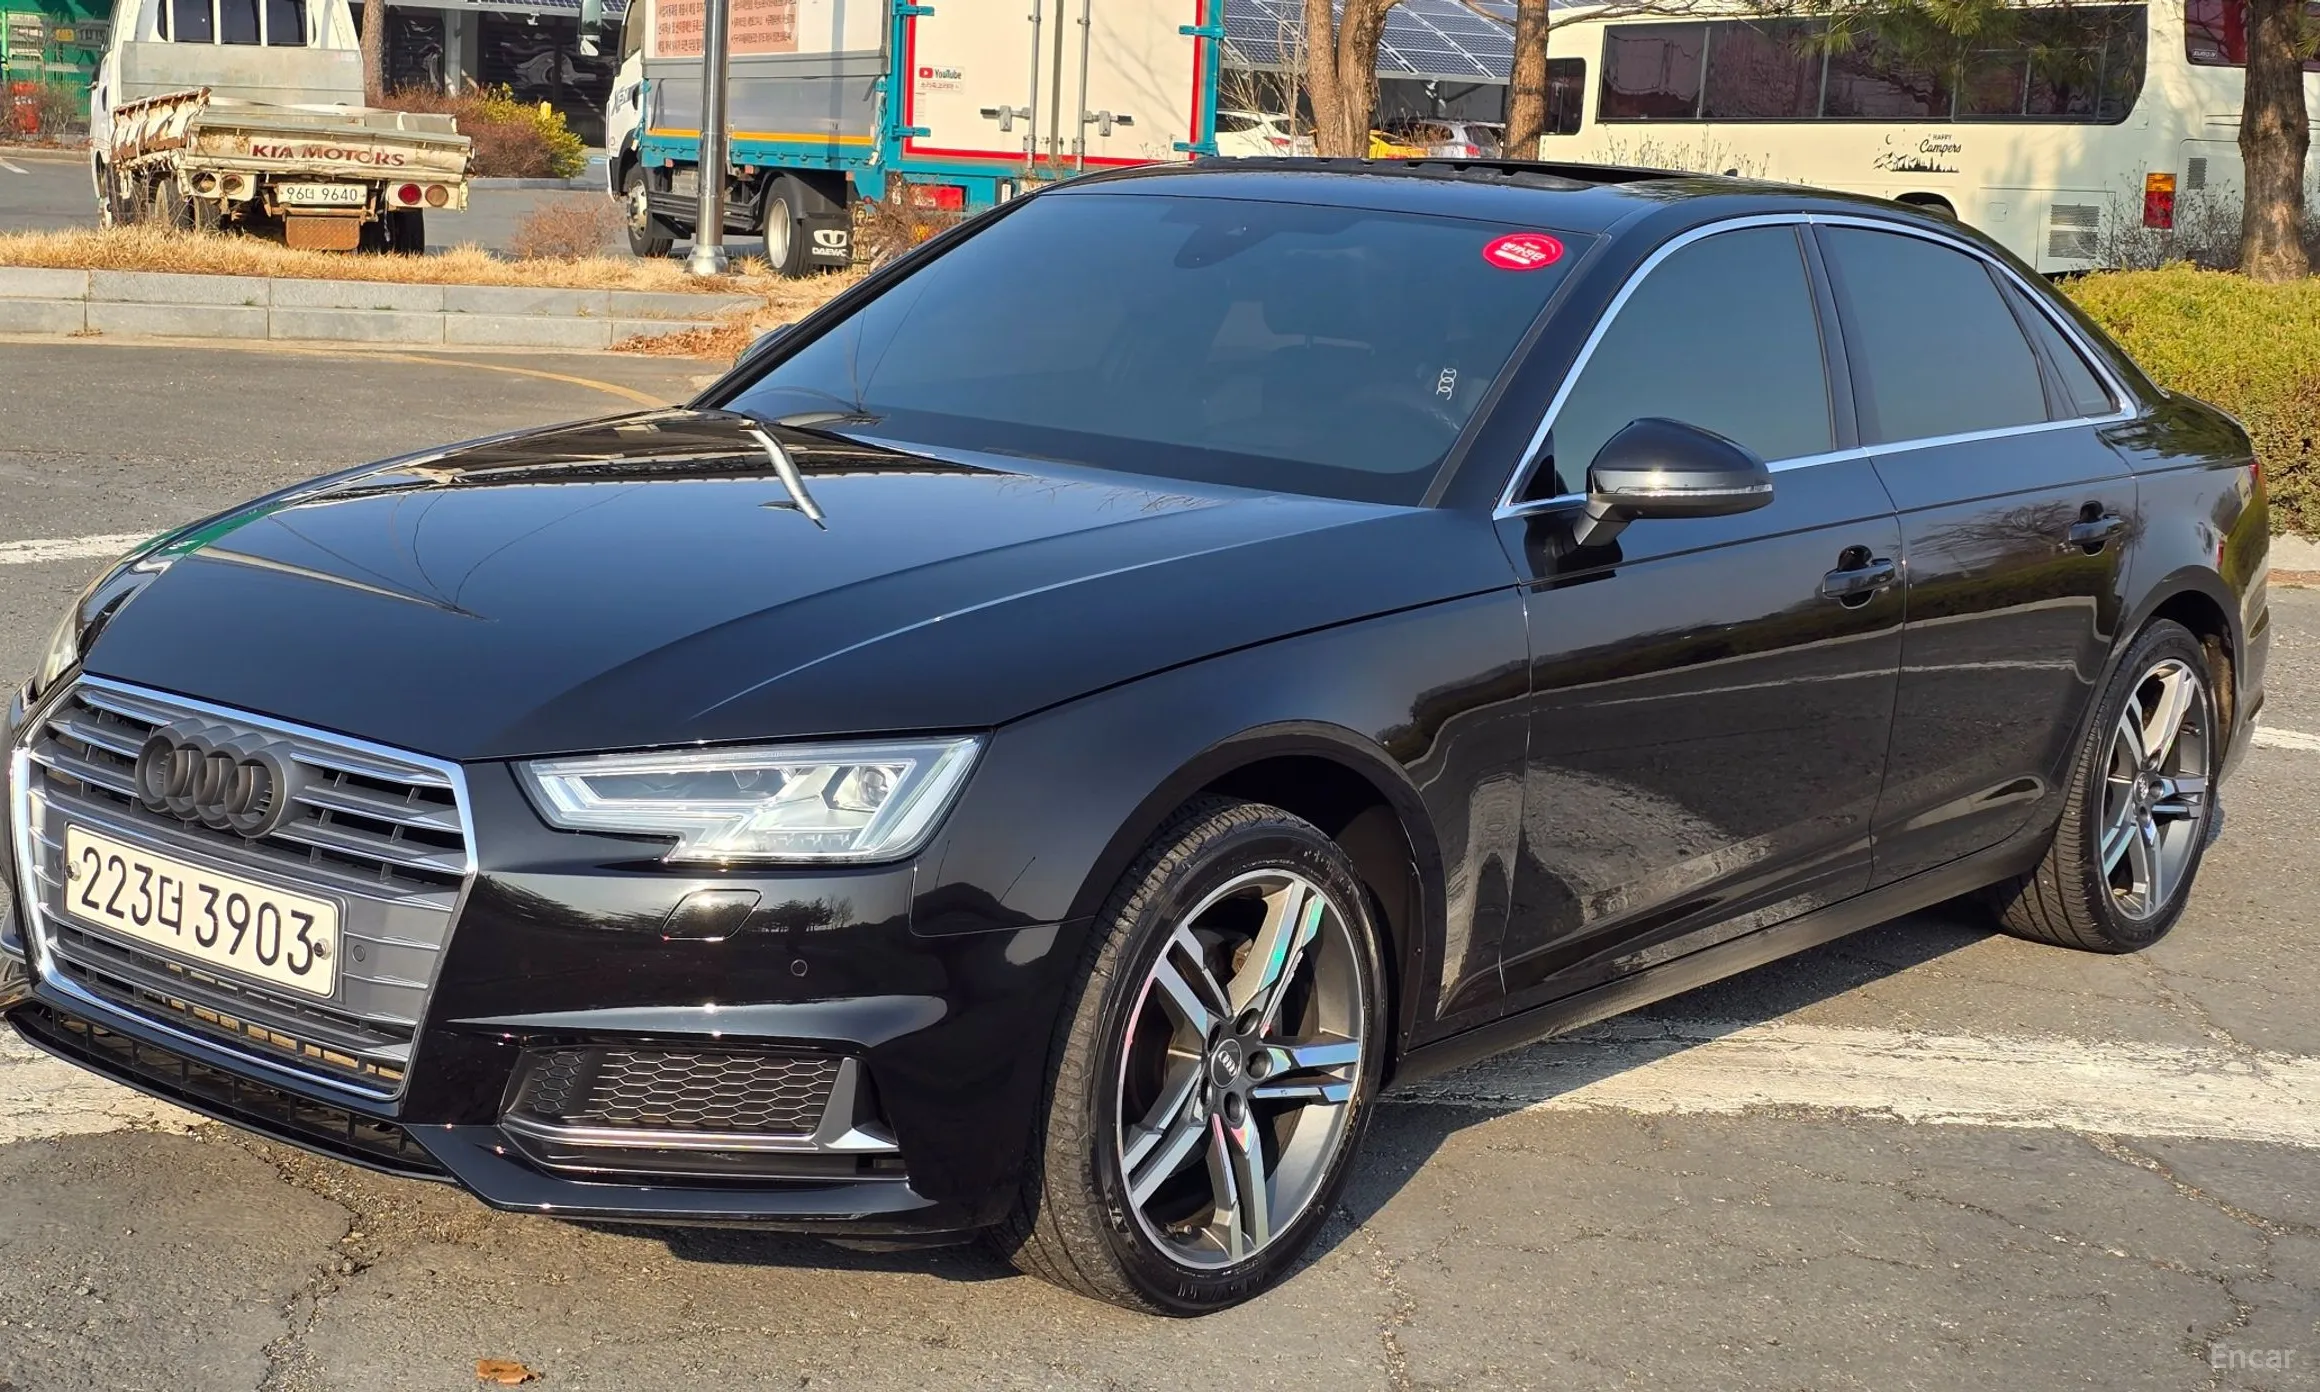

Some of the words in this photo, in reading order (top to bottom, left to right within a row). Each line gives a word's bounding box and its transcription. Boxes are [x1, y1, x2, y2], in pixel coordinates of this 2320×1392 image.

[935, 69, 961, 79] YouTube
[1932, 133, 1953, 141] HAPPY
[252, 144, 294, 158] KIA
[302, 144, 405, 166] MOTORS
[1919, 139, 1962, 157] Campers
[321, 188, 358, 201] 9640
[81, 846, 183, 936] 223더
[194, 882, 316, 976] 3903
